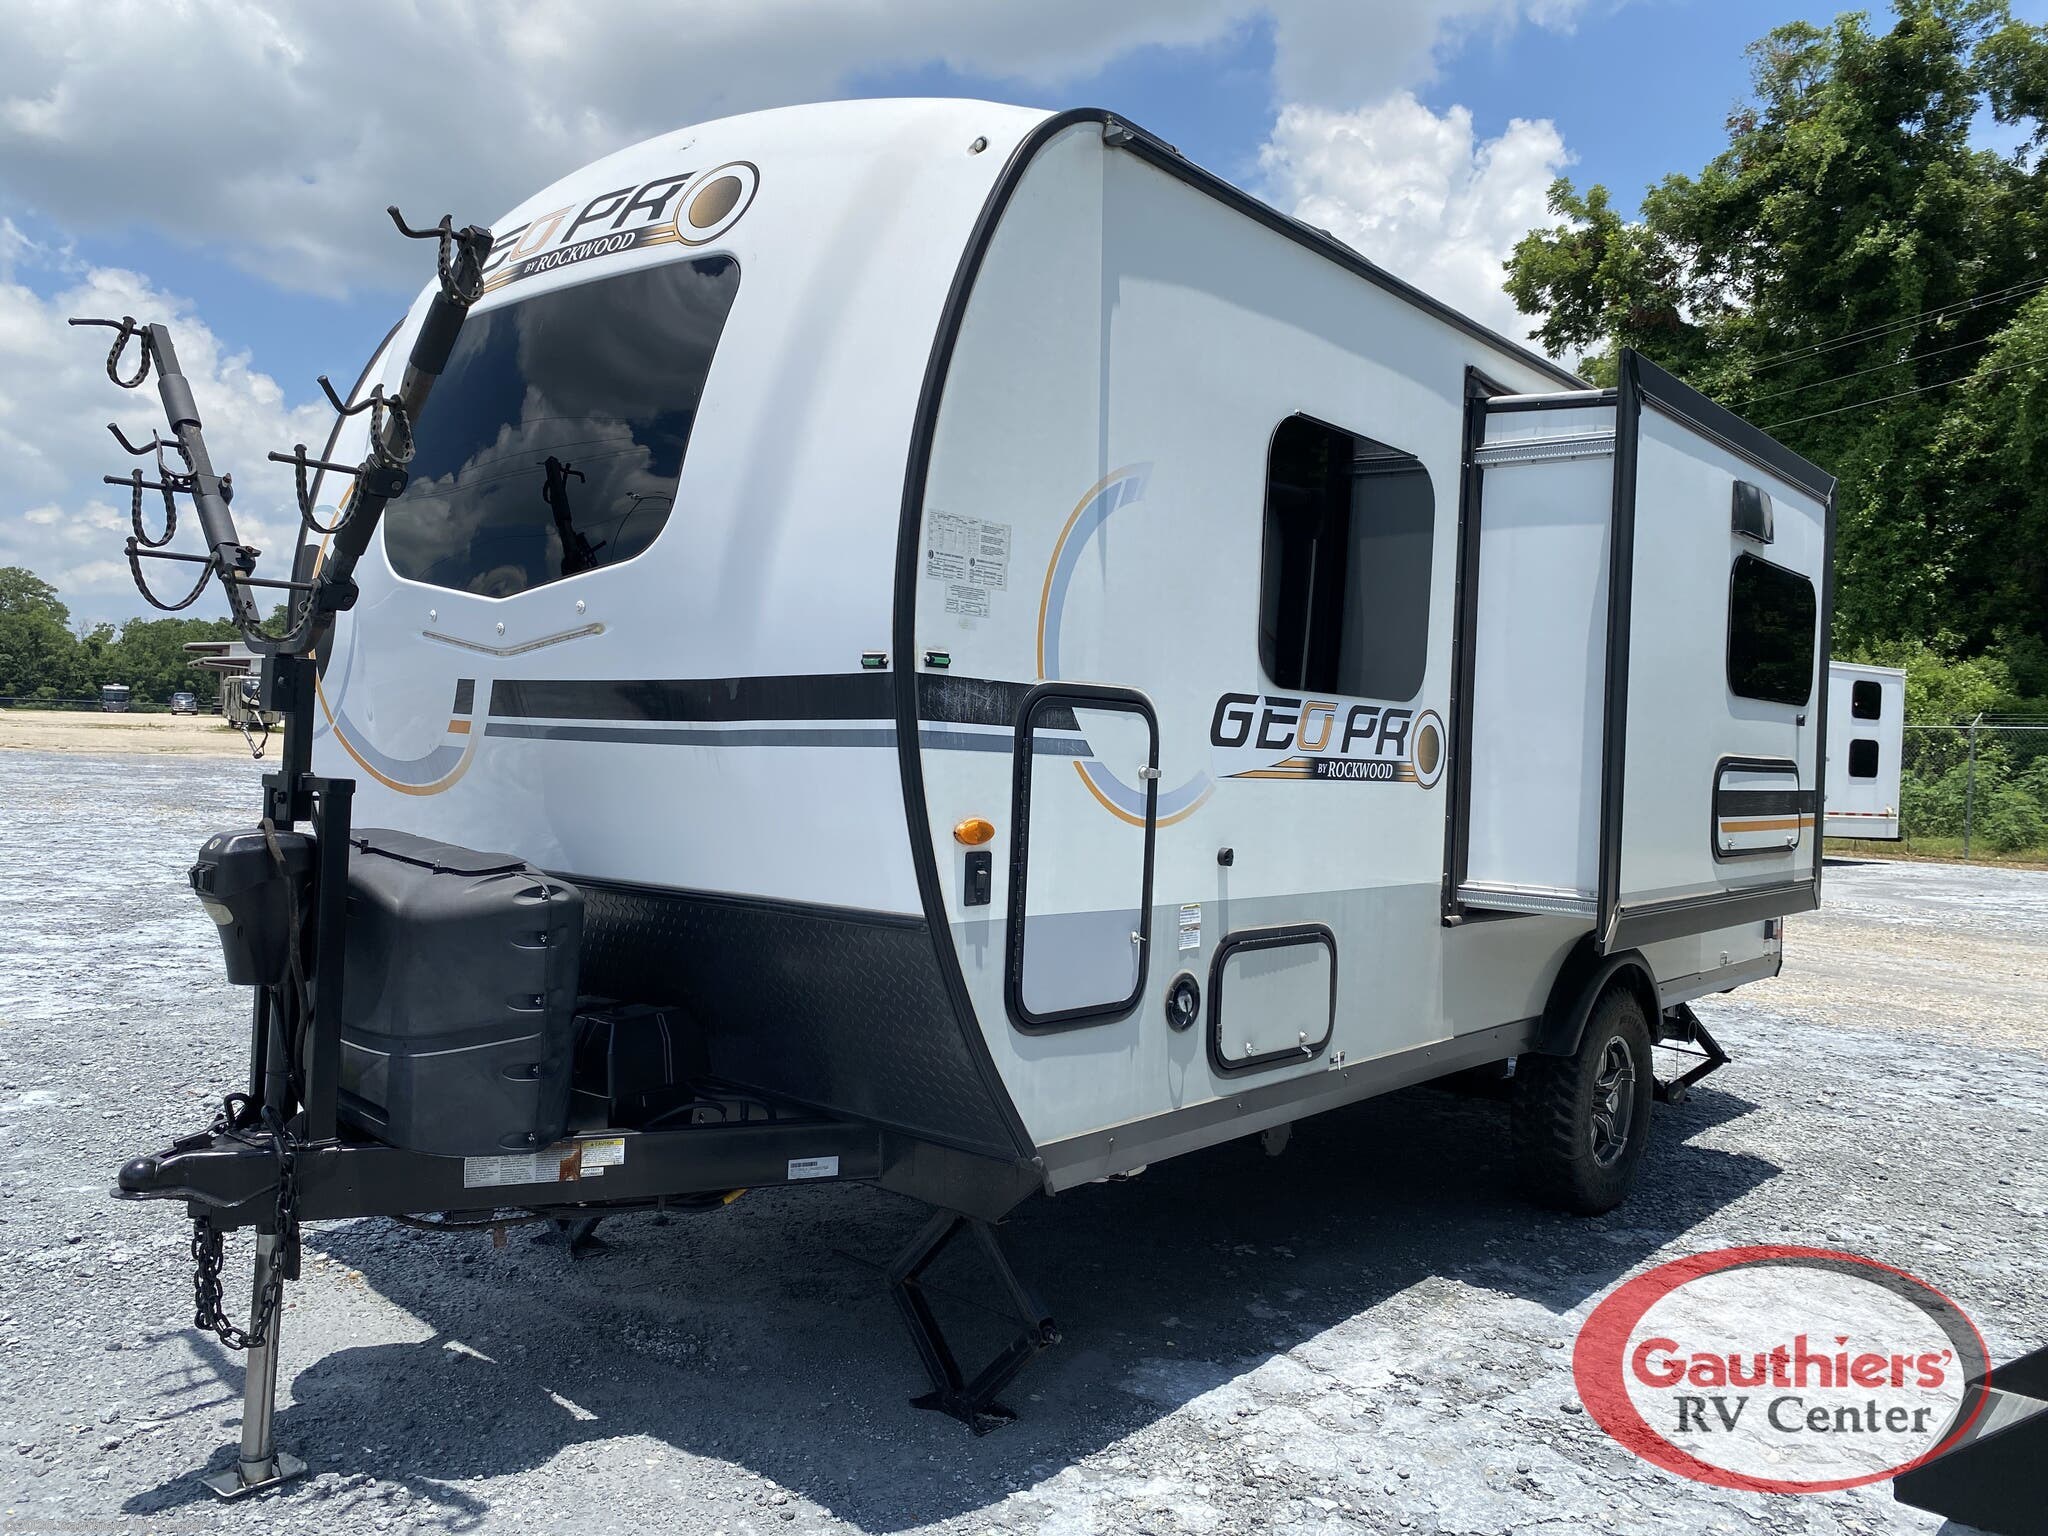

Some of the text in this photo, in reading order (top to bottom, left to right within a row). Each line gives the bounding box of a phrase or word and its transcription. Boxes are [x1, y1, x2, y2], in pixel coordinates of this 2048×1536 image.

[483, 160, 761, 272] EO PRO
[523, 232, 637, 274] BY ROCKWOOD
[1210, 692, 1447, 790] GEO PRO
[1317, 761, 1394, 780] BY ROCKWOOD
